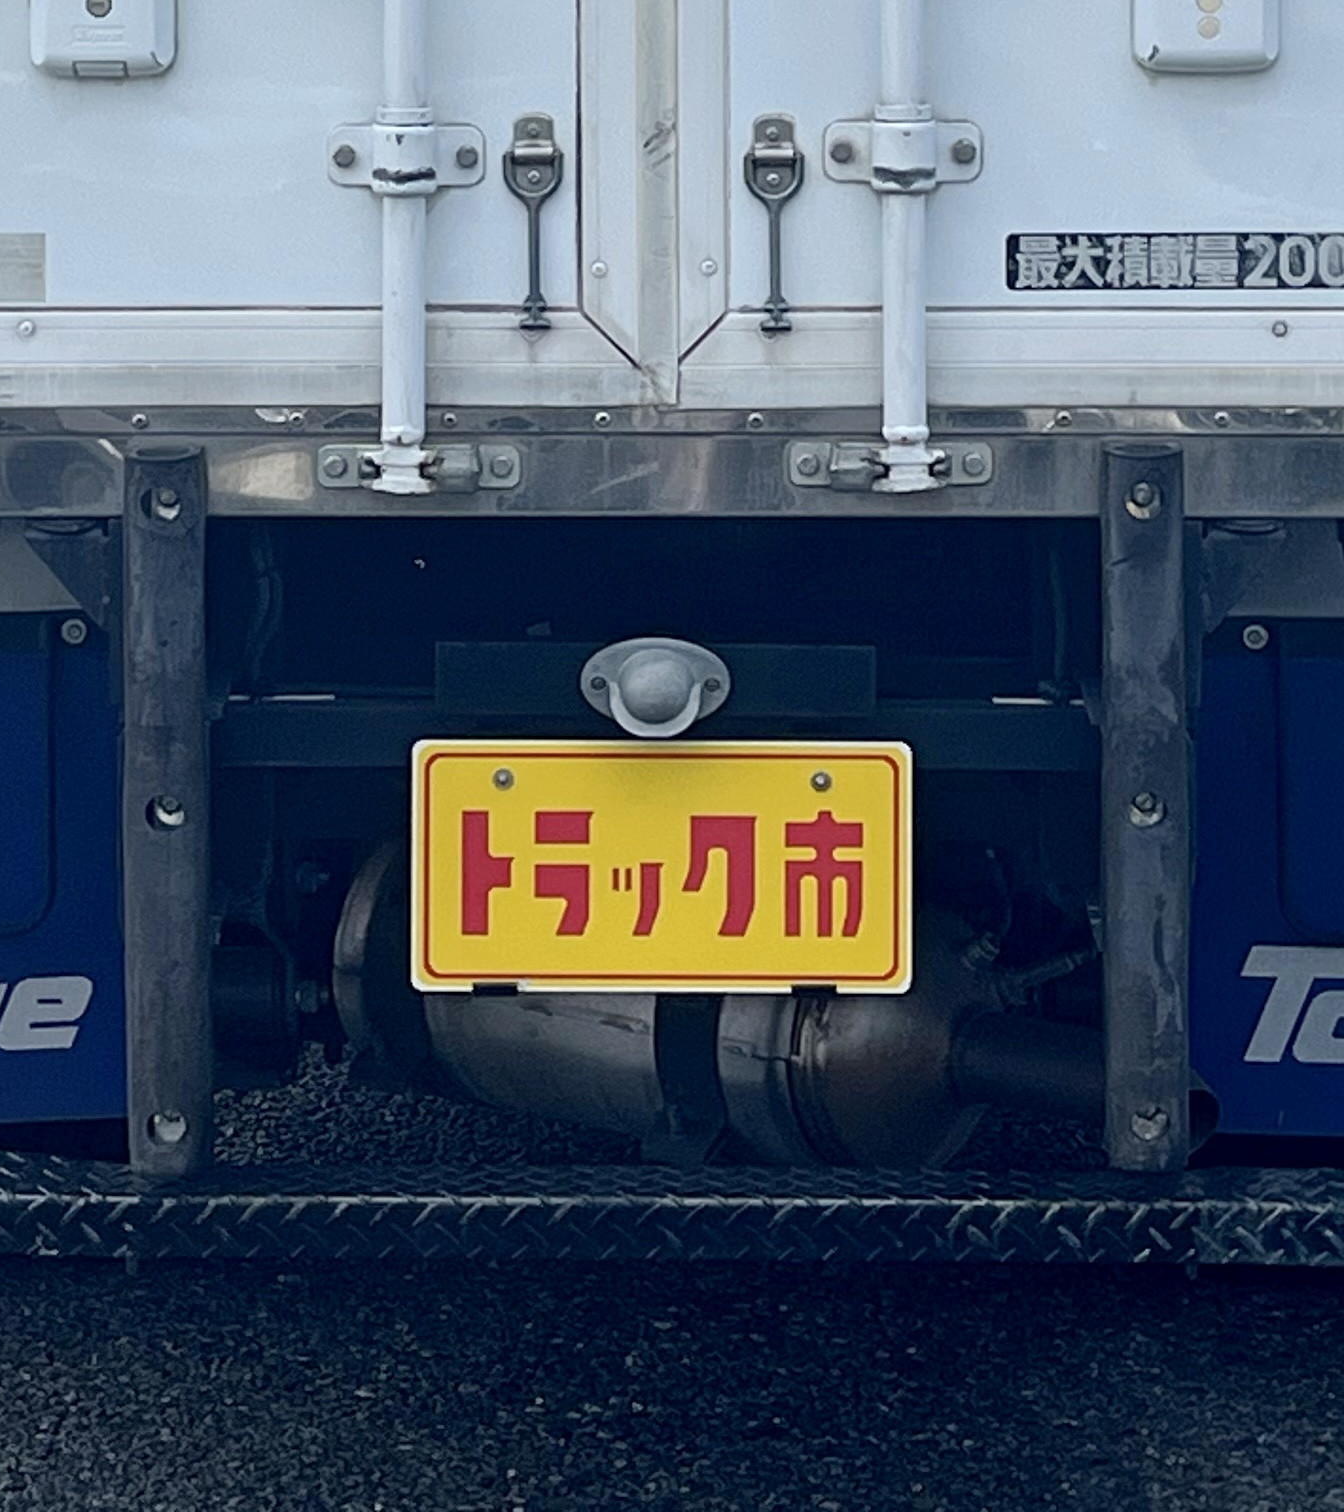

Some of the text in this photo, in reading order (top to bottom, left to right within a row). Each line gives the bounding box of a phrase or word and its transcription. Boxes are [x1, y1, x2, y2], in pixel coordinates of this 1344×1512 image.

[460, 809, 865, 937] トラック市
